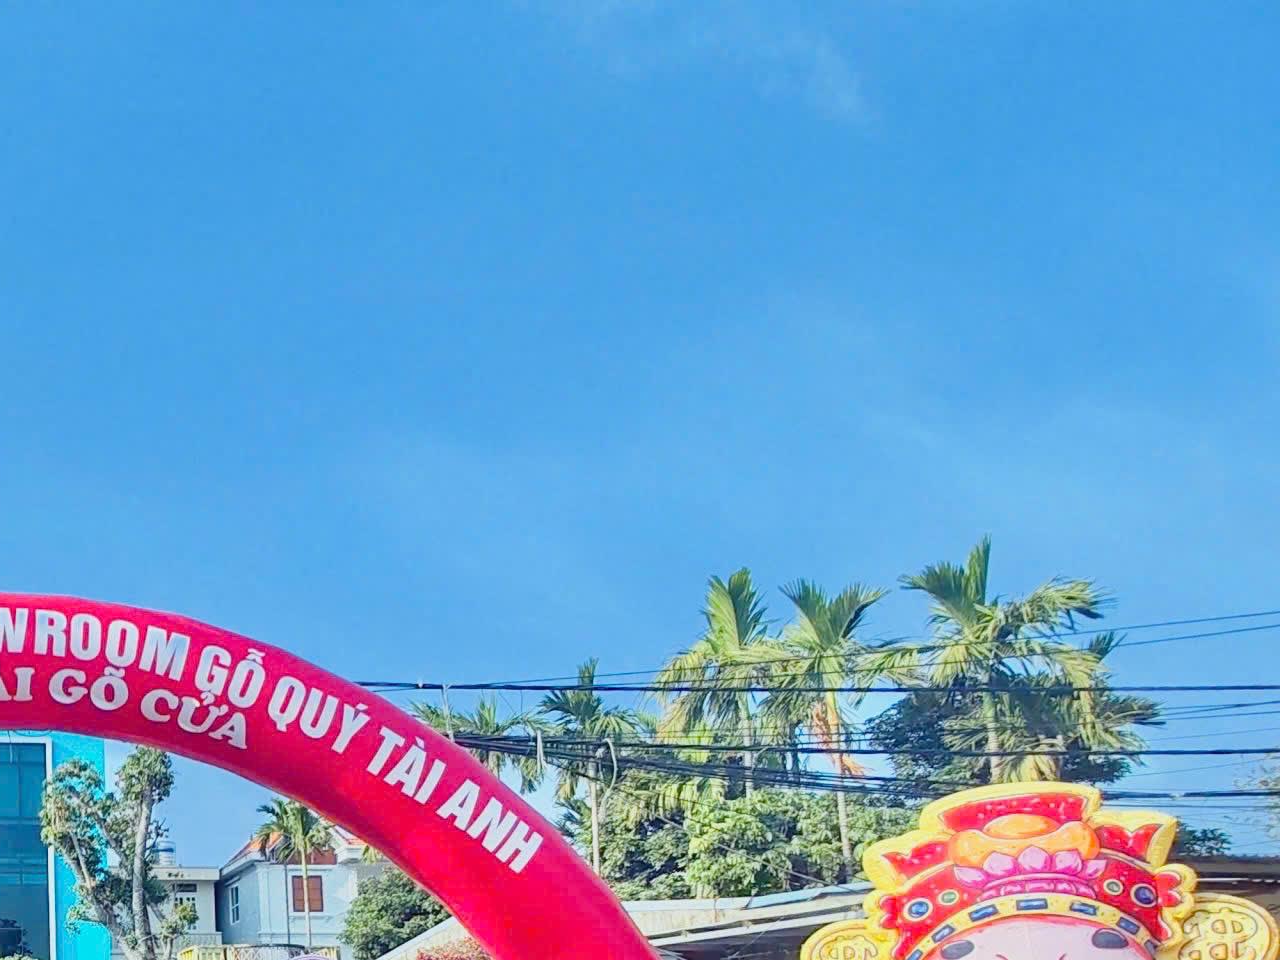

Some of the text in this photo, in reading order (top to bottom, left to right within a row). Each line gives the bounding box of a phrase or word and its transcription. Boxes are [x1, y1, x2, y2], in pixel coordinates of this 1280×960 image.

[48, 666, 129, 711] GÕ
[140, 689, 247, 750] CỬA
[194, 647, 267, 710] GỖ
[267, 676, 374, 754] QUÝ
[365, 725, 447, 804] TÀI
[435, 781, 543, 873] ANH
